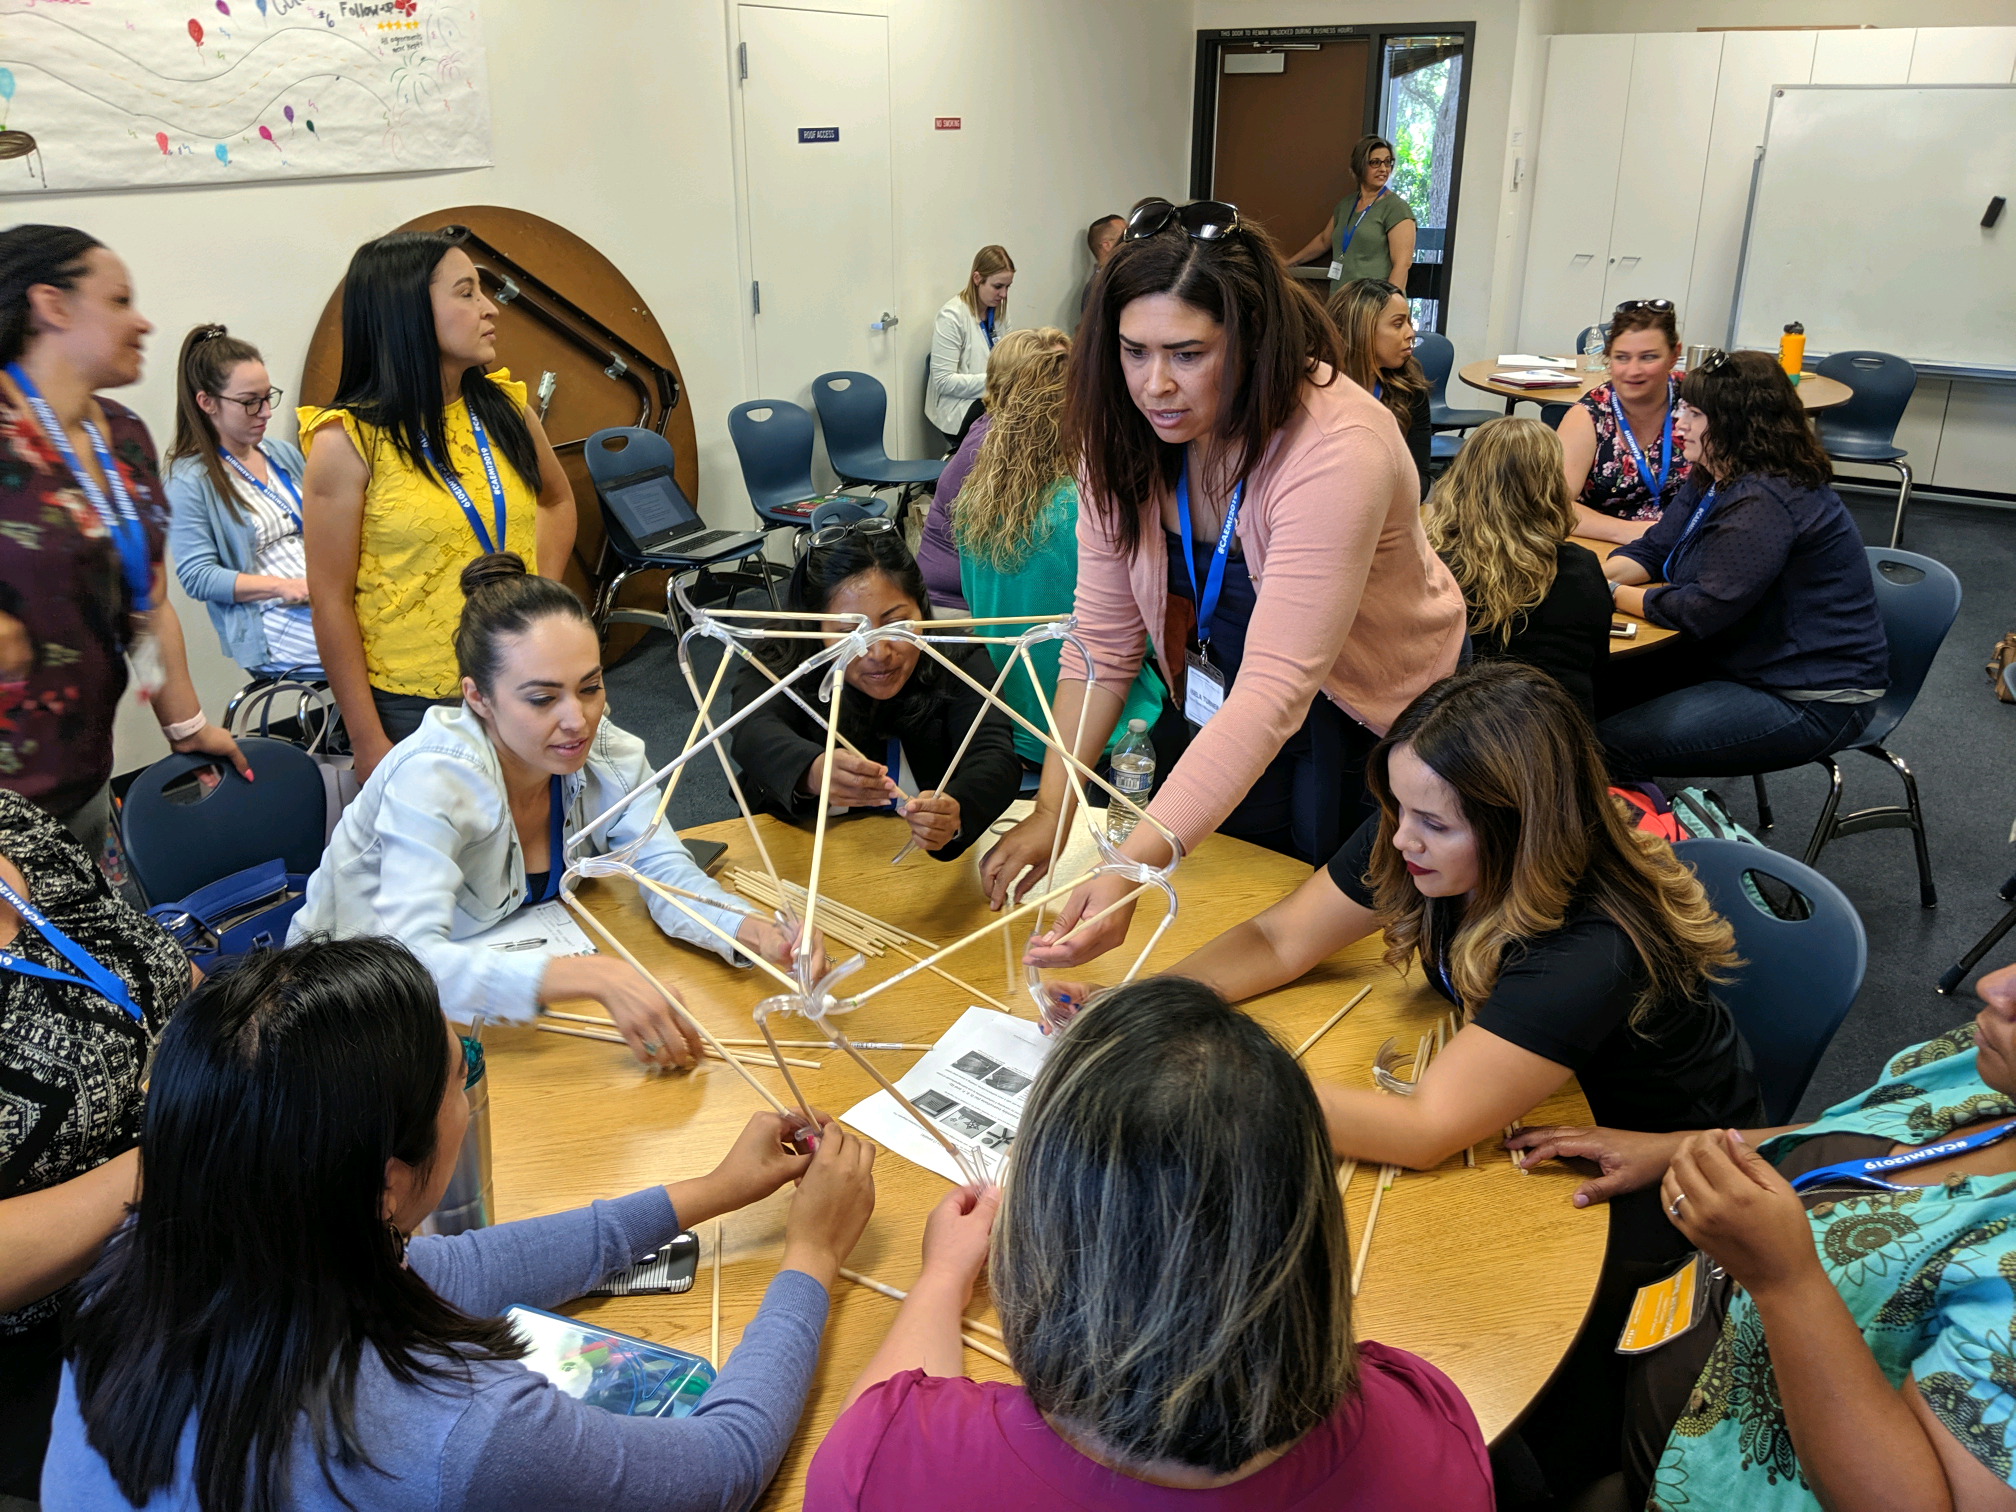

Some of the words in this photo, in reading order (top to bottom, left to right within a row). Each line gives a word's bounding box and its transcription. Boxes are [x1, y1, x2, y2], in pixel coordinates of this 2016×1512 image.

[803, 130, 816, 139] ROOF
[817, 130, 835, 138] ACCESS
[943, 119, 960, 127] SMOKING
[225, 454, 256, 483] #CAEMI2019
[481, 447, 501, 495] #CAEMI2019
[264, 488, 293, 515] #CAEMI2019
[1217, 492, 1238, 555] #CAEMI2019
[1864, 1140, 1968, 1170] #CAEMI2019
